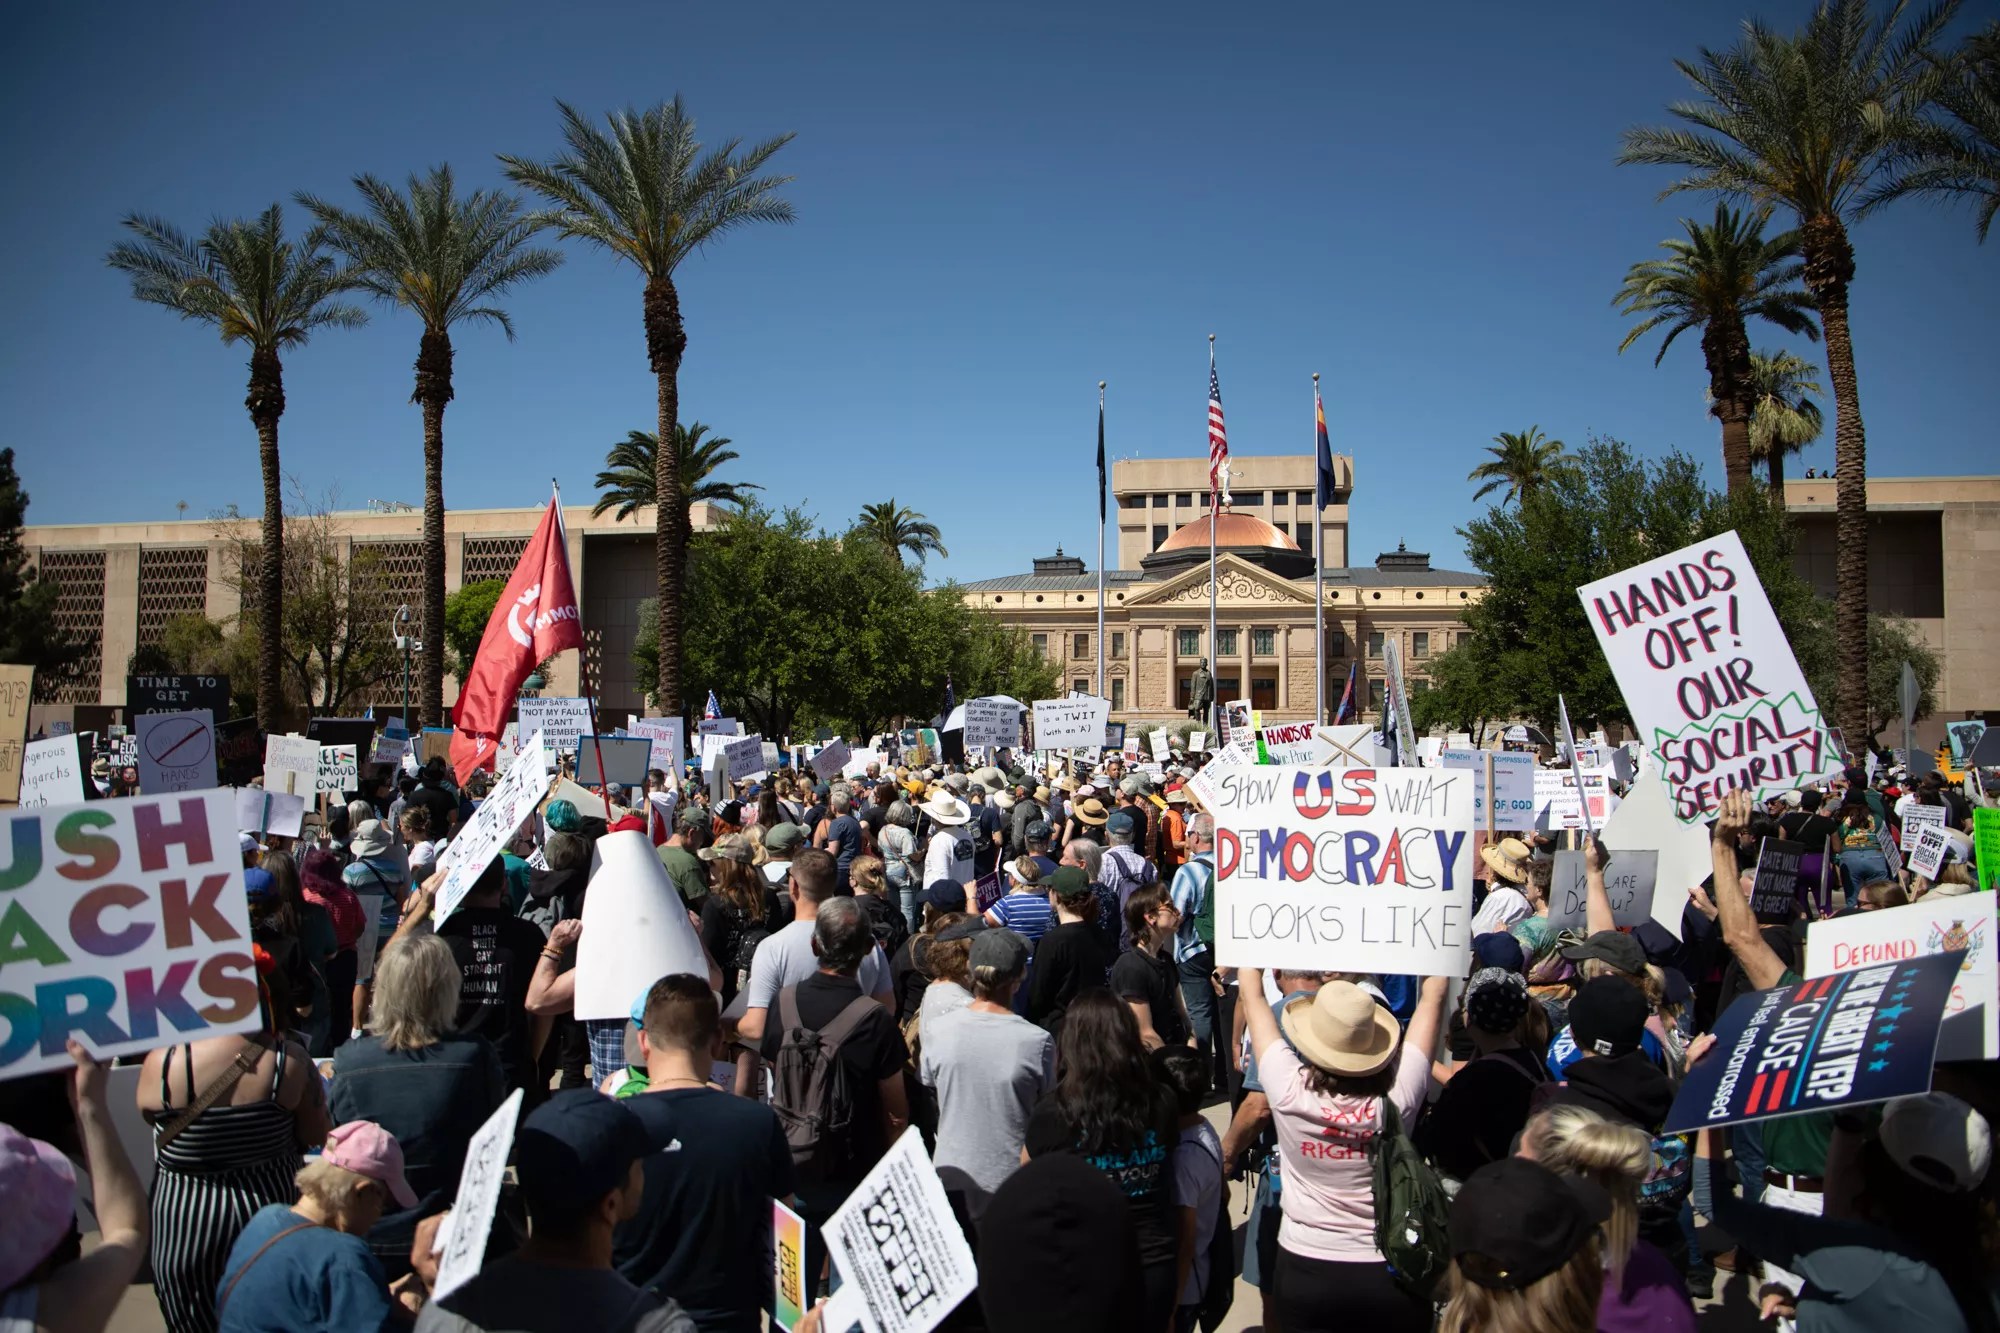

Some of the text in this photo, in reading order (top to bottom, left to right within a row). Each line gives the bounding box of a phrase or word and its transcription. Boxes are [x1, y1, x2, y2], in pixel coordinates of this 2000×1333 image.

[1594, 550, 1738, 636] HANDS
[1645, 594, 1742, 670] OFF!
[136, 677, 216, 688] TIME TO
[1677, 657, 1770, 720] OUR
[156, 690, 190, 701] GET
[1064, 711, 1096, 721] TWIT
[1266, 725, 1301, 746] HANDS
[1661, 706, 1812, 785] SOCIAL
[1444, 752, 1471, 760] EMPATHY
[1493, 756, 1532, 764] COMPASSION
[161, 768, 200, 782] HANDS
[316, 778, 345, 790] OW!
[1673, 729, 1823, 820] SECURITY
[1220, 769, 1458, 820] SHOW US WHAT
[1494, 799, 1506, 810] OF
[1512, 800, 1532, 810] GOD
[1920, 835, 1942, 851] OFF!
[1923, 828, 1945, 842] HANDS
[1216, 826, 1467, 892] DEMOCRACY
[1760, 850, 1800, 872] HATE WILL
[1916, 846, 1938, 860] SOCIAL
[0, 872, 242, 968] ACK
[1232, 903, 1462, 950] LOOKS LIKE
[472, 925, 497, 935] BLACK
[476, 951, 492, 962] GAY
[1834, 938, 1917, 970] DEFUND
[464, 964, 502, 976] STRAIGHT
[463, 981, 498, 993] HUMAN
[1756, 997, 1828, 1074] 'CAUSE
[1818, 1006, 1876, 1054] GREAT
[1706, 1026, 1760, 1120] embarrassed
[1806, 1053, 1860, 1101] YET?
[1320, 1106, 1376, 1124] SAVE
[1300, 1142, 1366, 1160] RIGH
[1120, 1164, 1160, 1181] YOUR
[879, 1186, 934, 1299] HANDS
